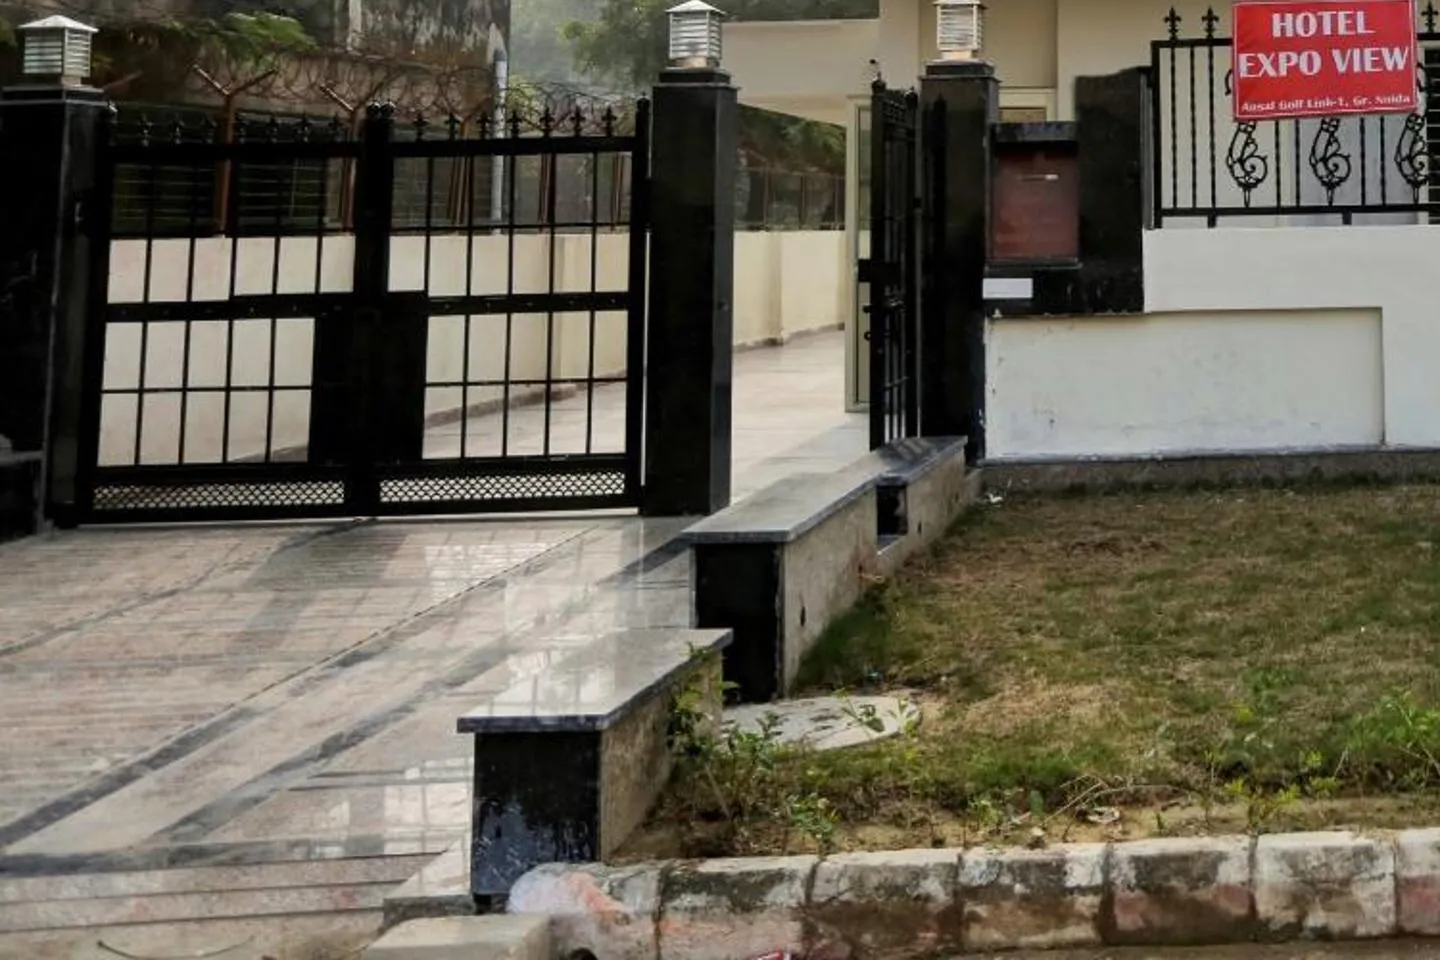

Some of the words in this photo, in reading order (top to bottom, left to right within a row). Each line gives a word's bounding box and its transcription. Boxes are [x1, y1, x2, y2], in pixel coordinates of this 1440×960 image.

[1272, 10, 1376, 38] HOTEL
[1239, 49, 1323, 78] EXPO
[1331, 45, 1410, 73] VIEW
